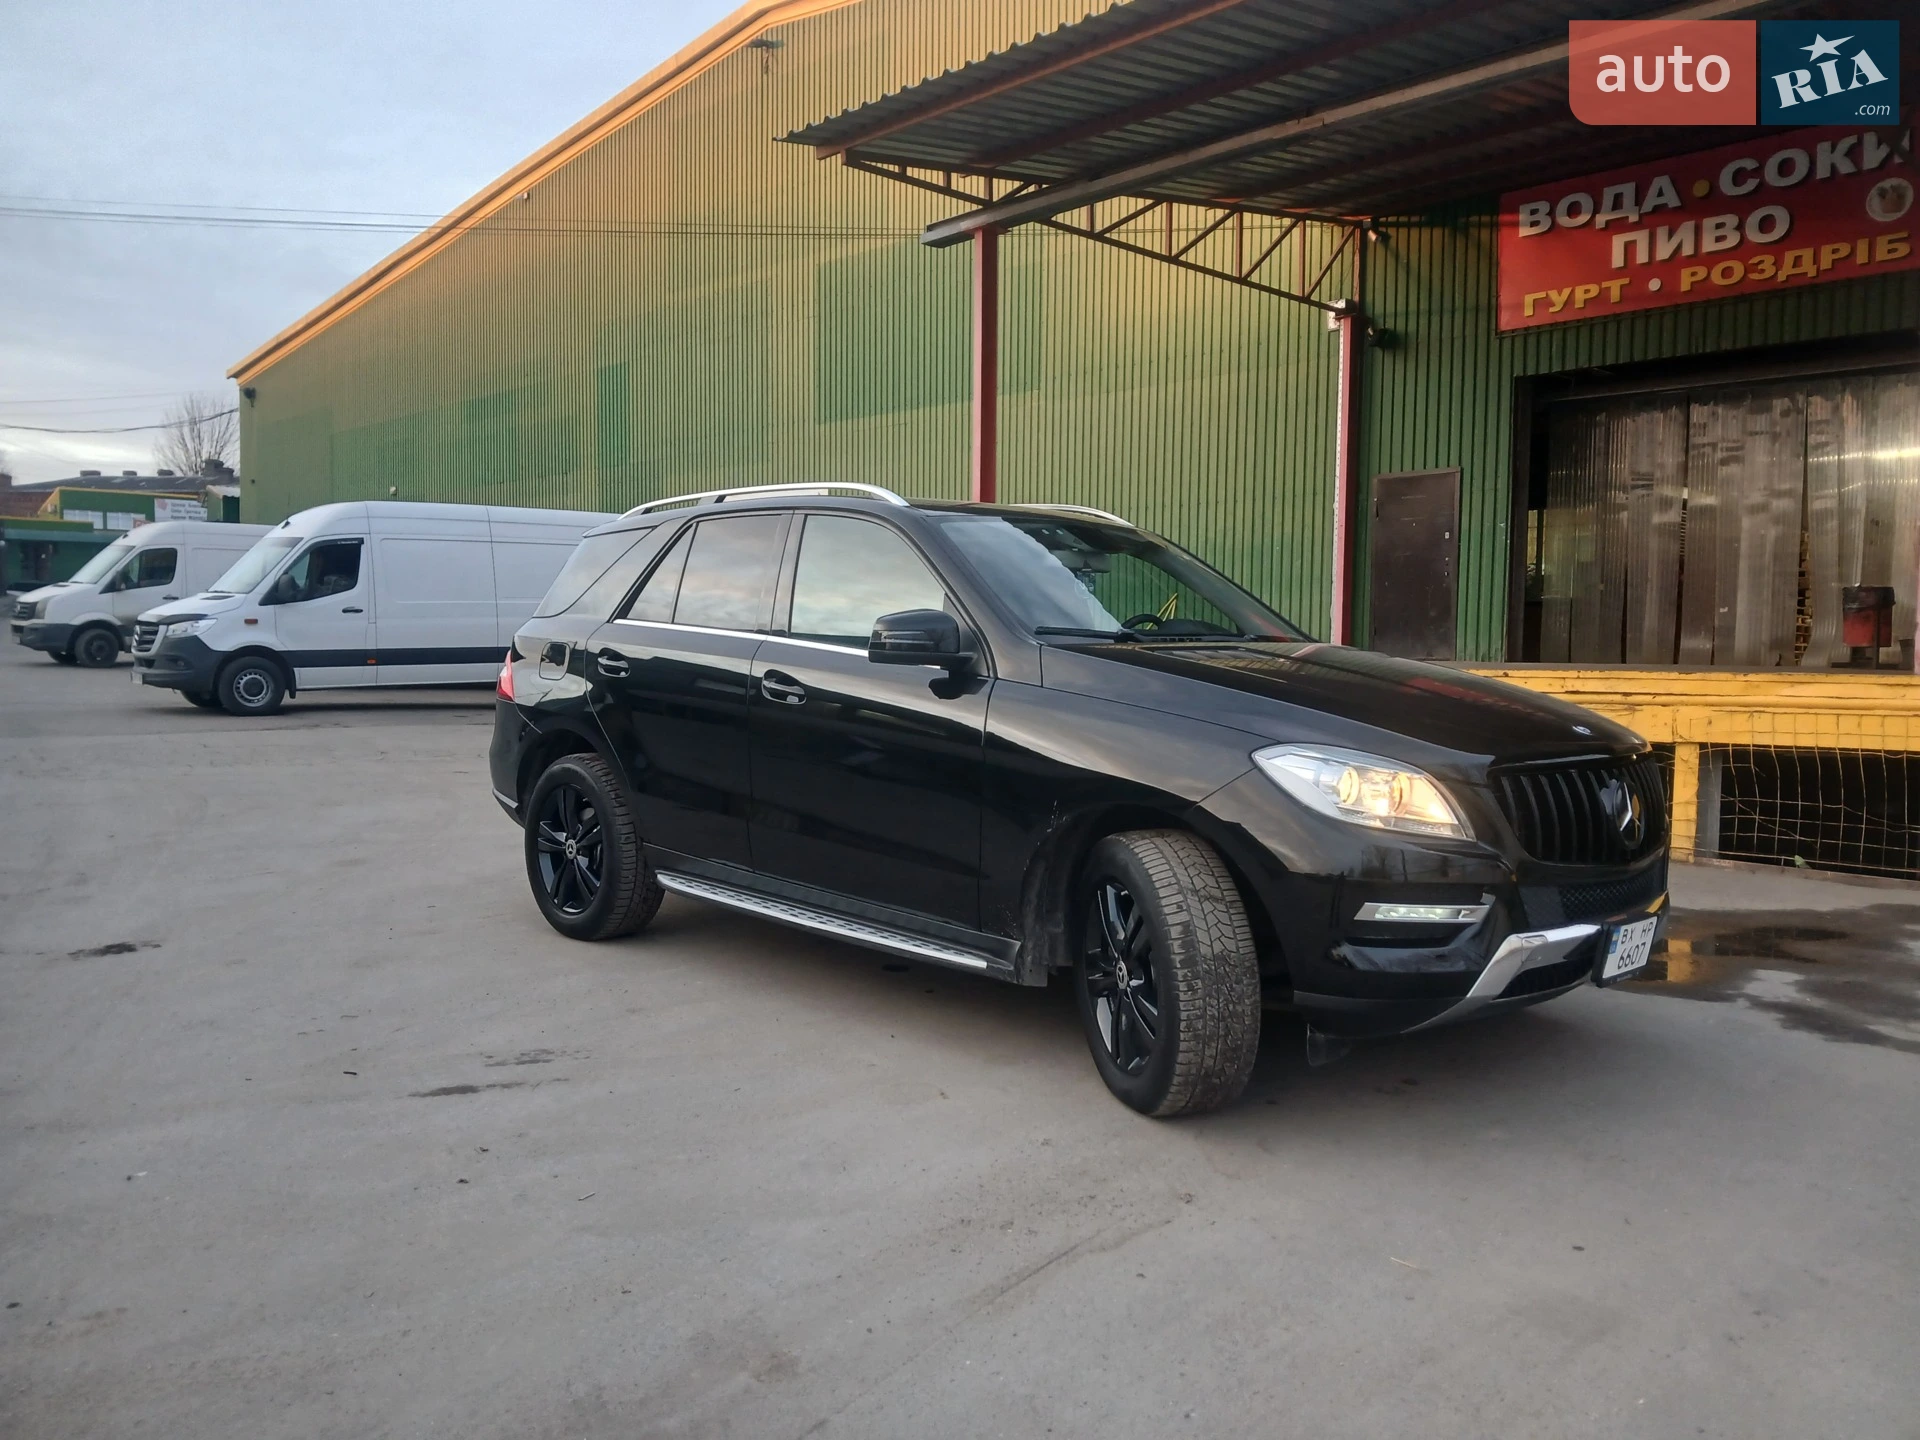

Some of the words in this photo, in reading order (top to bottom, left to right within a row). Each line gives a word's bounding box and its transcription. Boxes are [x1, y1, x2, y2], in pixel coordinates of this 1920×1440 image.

[1518, 174, 1682, 237] ВОДА
[1611, 205, 1791, 269] ПИВО
[1523, 277, 1631, 317] ГУРТ
[1680, 231, 1911, 293] РОЗДРІБ
[1617, 941, 1647, 970] 6607
